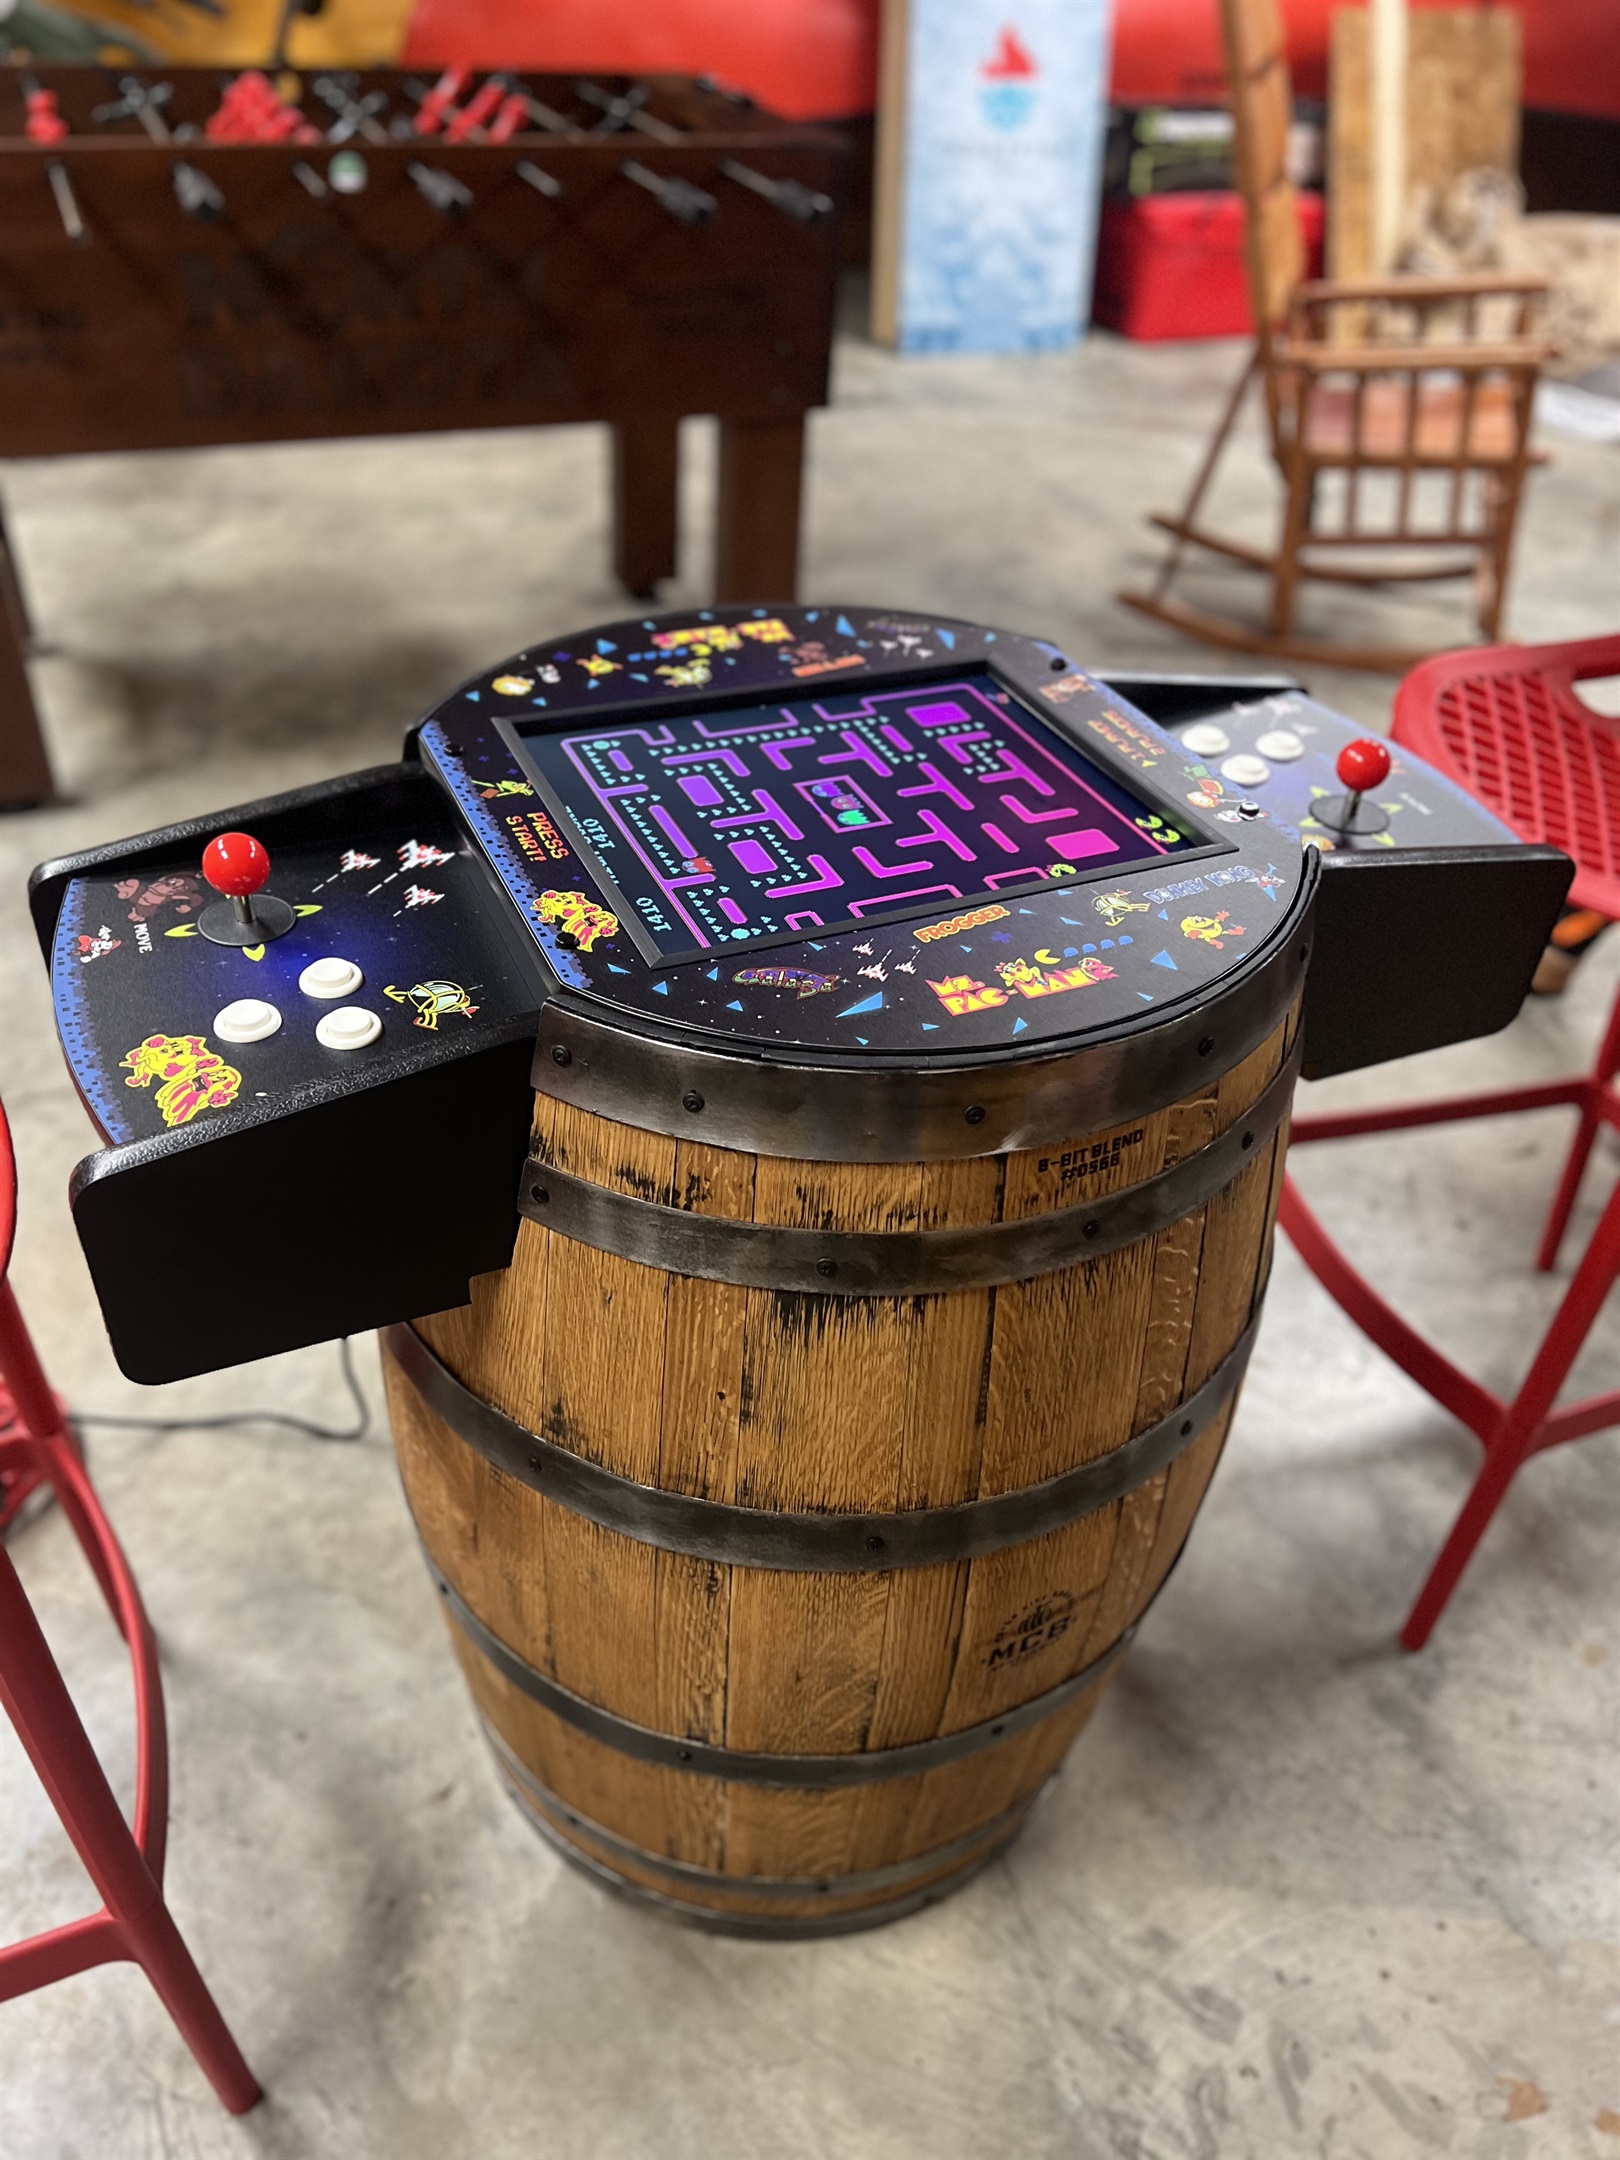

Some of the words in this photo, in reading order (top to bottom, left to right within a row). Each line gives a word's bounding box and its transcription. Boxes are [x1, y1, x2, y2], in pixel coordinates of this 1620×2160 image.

[506, 815, 547, 861] START!
[527, 812, 569, 859] PRESS
[582, 818, 615, 849] 1410
[1143, 877, 1209, 904] DONKEY
[1204, 865, 1256, 887] KONG
[636, 897, 672, 931] 1410
[913, 905, 1011, 943] FROGGER
[134, 923, 153, 954] MOVE
[1091, 1129, 1144, 1158] BLEND
[988, 1616, 1070, 1667] MCB
